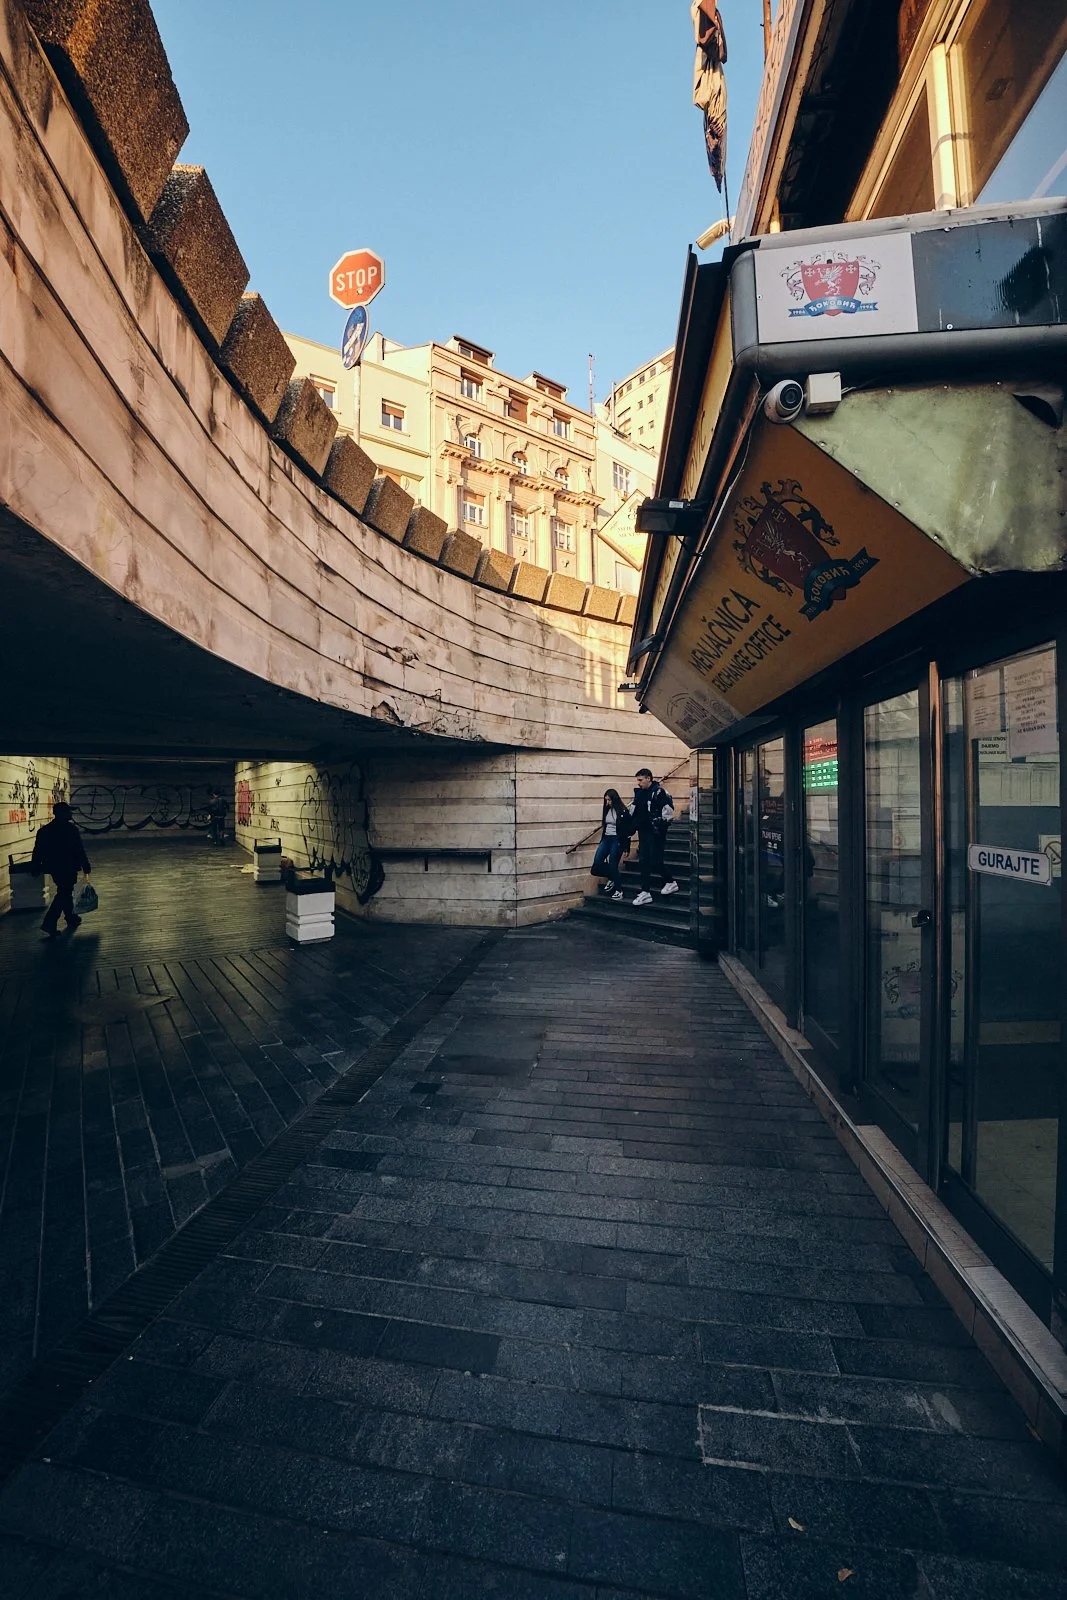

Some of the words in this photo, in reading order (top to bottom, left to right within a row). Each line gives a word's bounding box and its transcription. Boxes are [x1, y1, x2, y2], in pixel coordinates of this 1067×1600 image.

[335, 265, 378, 292] STOP
[688, 588, 761, 676] MENJAČNICA
[711, 649, 757, 693] EXCHANGE
[744, 614, 792, 660] OFFICE
[978, 851, 1040, 876] GURAJTE
